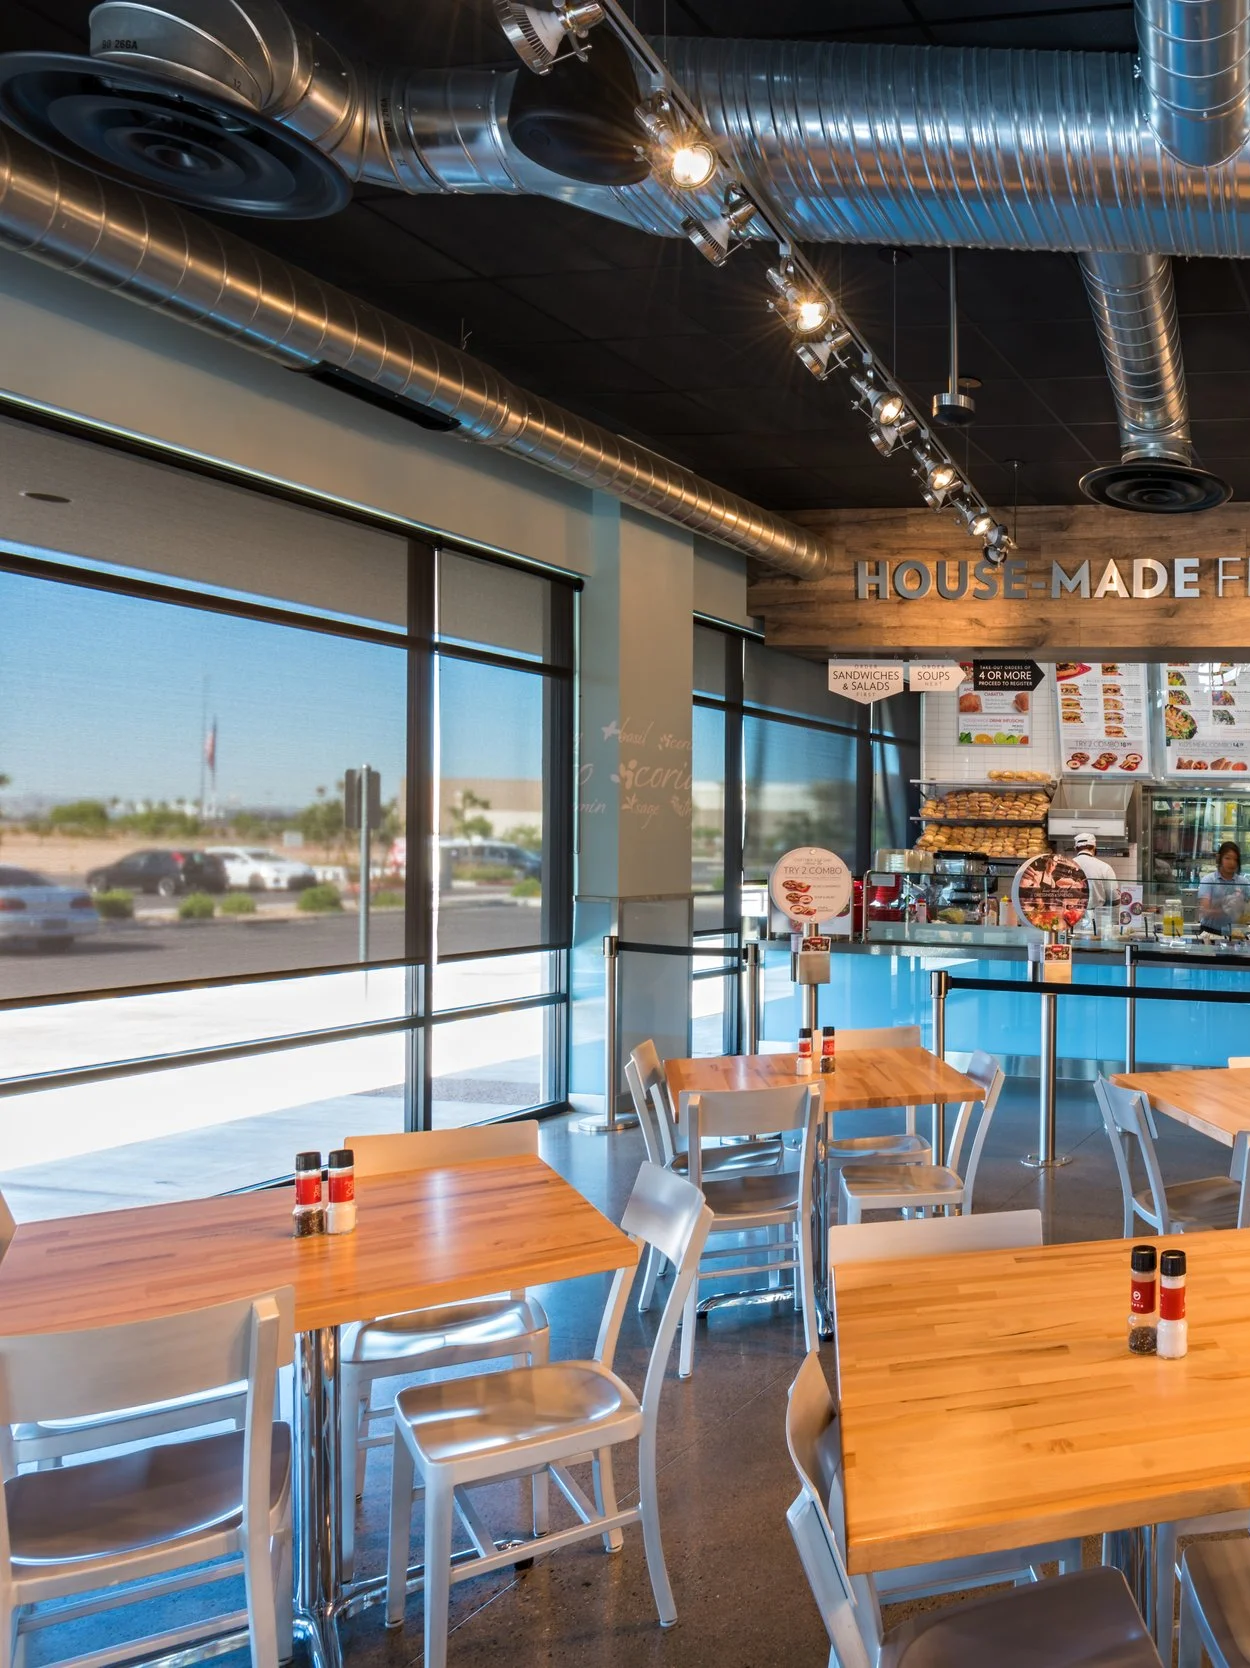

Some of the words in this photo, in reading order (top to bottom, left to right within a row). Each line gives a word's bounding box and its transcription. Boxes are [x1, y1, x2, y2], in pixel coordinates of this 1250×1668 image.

[855, 558, 1201, 600] HOUSE-MADE
[832, 670, 900, 681] SANDWICHES
[917, 671, 950, 681] SOUPS
[979, 671, 986, 680] 4
[987, 671, 1002, 680] OR
[1003, 671, 1032, 680] MORE
[842, 683, 849, 691] &
[851, 682, 890, 691] SALADS
[783, 866, 799, 875] TRY
[801, 866, 807, 875] 2
[808, 866, 843, 875] COMBO
